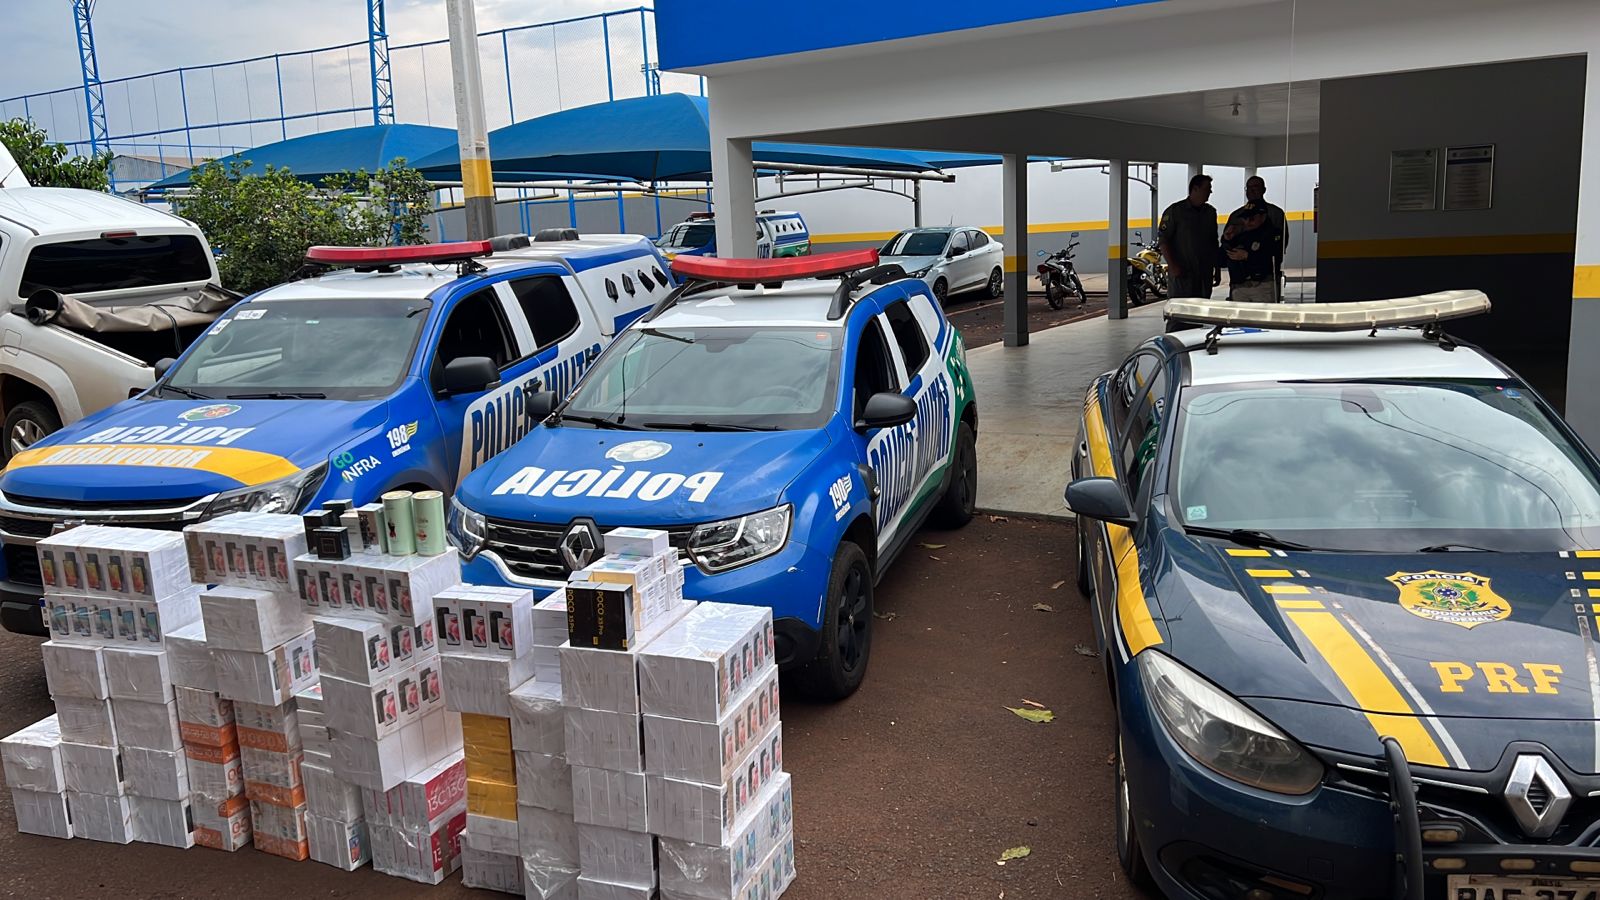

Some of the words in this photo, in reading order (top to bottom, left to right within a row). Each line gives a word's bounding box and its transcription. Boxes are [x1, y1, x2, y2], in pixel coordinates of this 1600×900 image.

[386, 424, 408, 449] 198
[332, 451, 354, 469] GO
[341, 455, 381, 483] INFRA
[829, 478, 848, 510] 190
[567, 589, 575, 613] POCO
[596, 591, 604, 615] POCO
[1429, 661, 1564, 694] PRF
